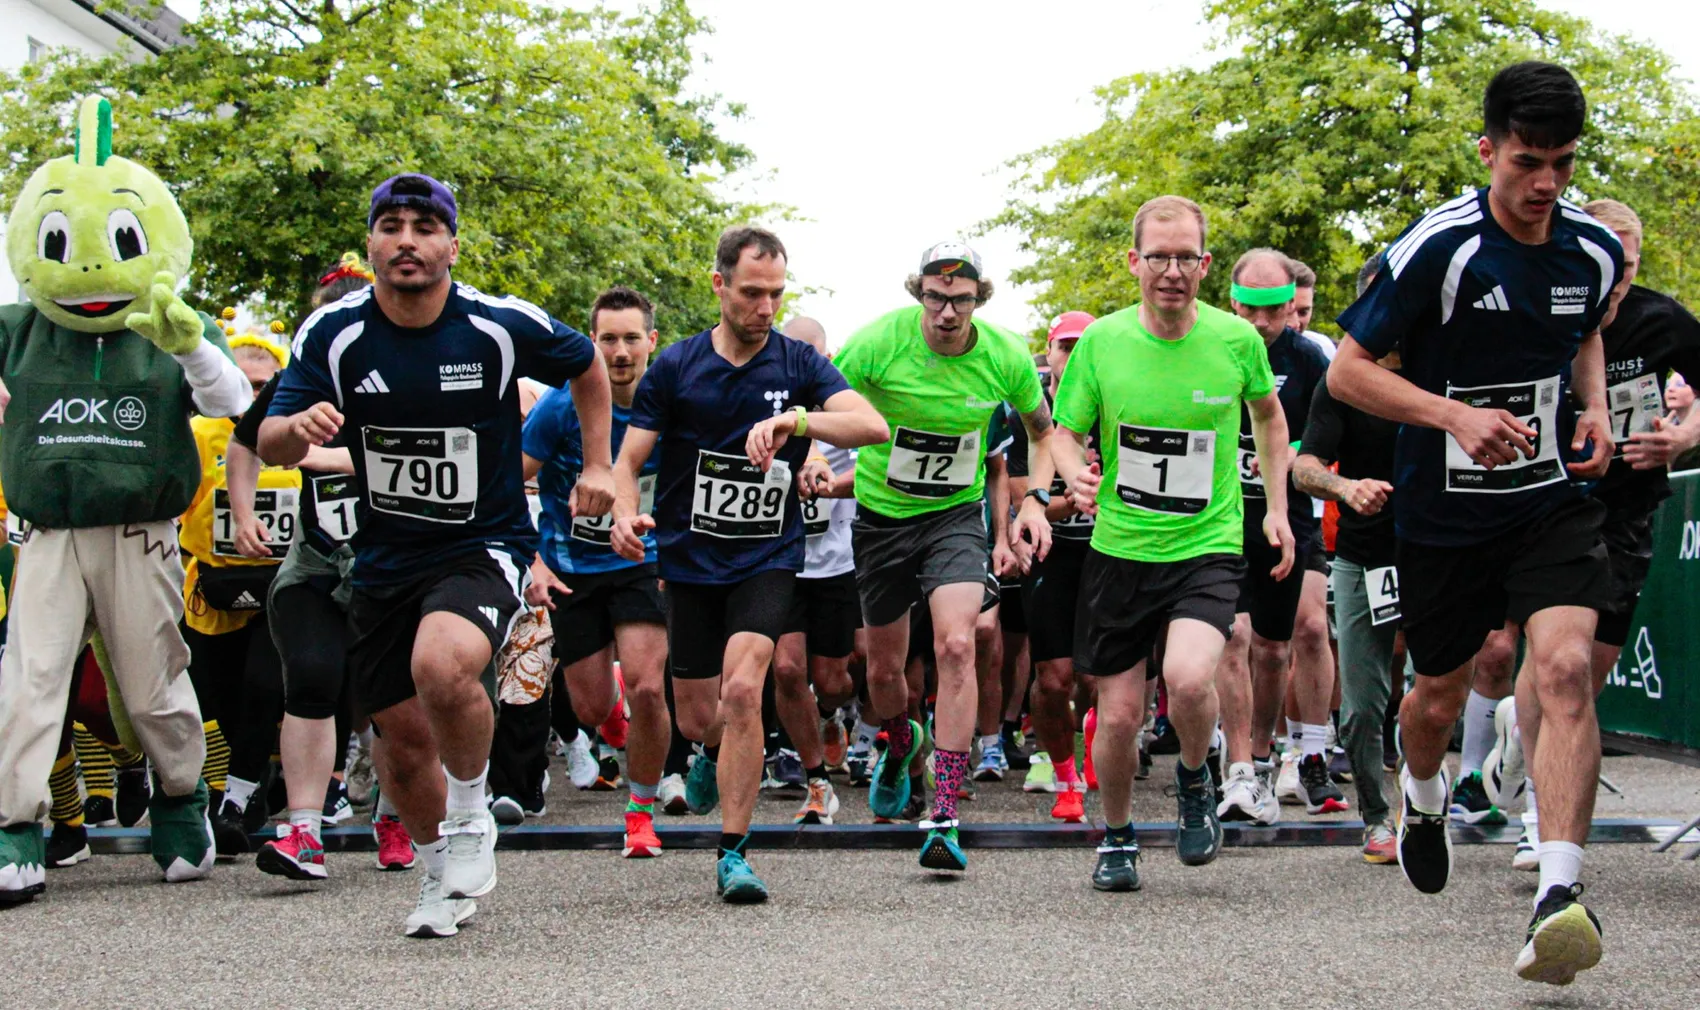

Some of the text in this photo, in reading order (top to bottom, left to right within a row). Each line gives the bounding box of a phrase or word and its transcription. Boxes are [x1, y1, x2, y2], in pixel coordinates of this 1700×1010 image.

[1551, 286, 1589, 297] KOMPASS
[439, 362, 483, 375] KOMPASS
[38, 398, 109, 424] AOK
[38, 434, 147, 448] Die Gesundheitskasse.
[380, 456, 459, 501] 790
[915, 454, 954, 482] 12
[1152, 457, 1169, 493] 1
[699, 480, 783, 520] 1289
[217, 511, 295, 543] 129
[1381, 568, 1398, 599] 4
